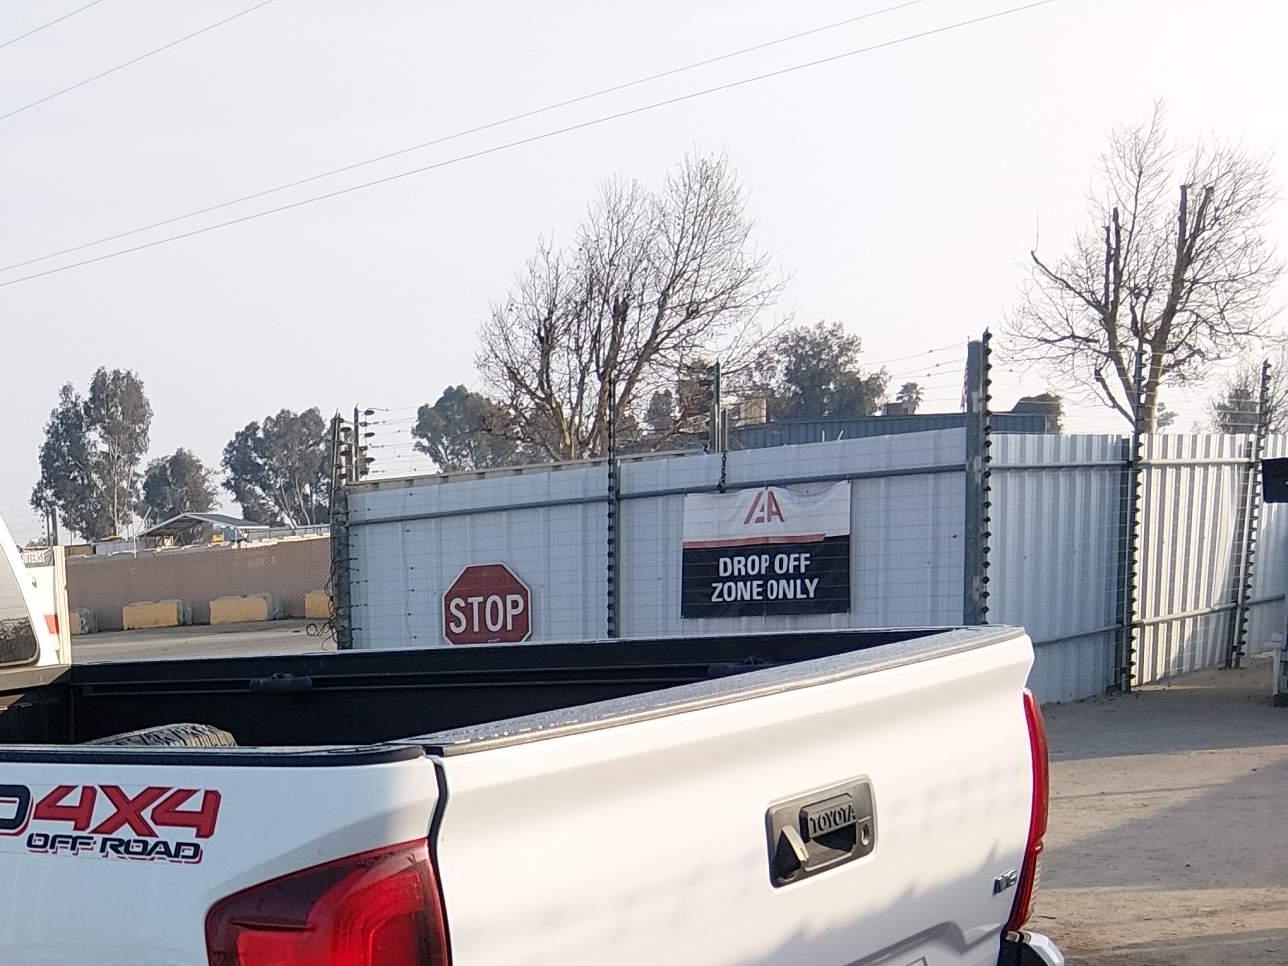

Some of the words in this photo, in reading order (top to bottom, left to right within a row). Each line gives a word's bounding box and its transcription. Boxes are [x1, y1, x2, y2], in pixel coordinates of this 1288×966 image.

[718, 554, 770, 577] DROP
[774, 553, 811, 575] OFF
[711, 580, 763, 603] ZONE
[766, 578, 820, 600] ONLY
[449, 594, 524, 634] STOP
[32, 784, 223, 840] 4X4
[809, 804, 857, 834] TOYOTA
[25, 832, 98, 858] OFF
[98, 837, 204, 865] ROAD
